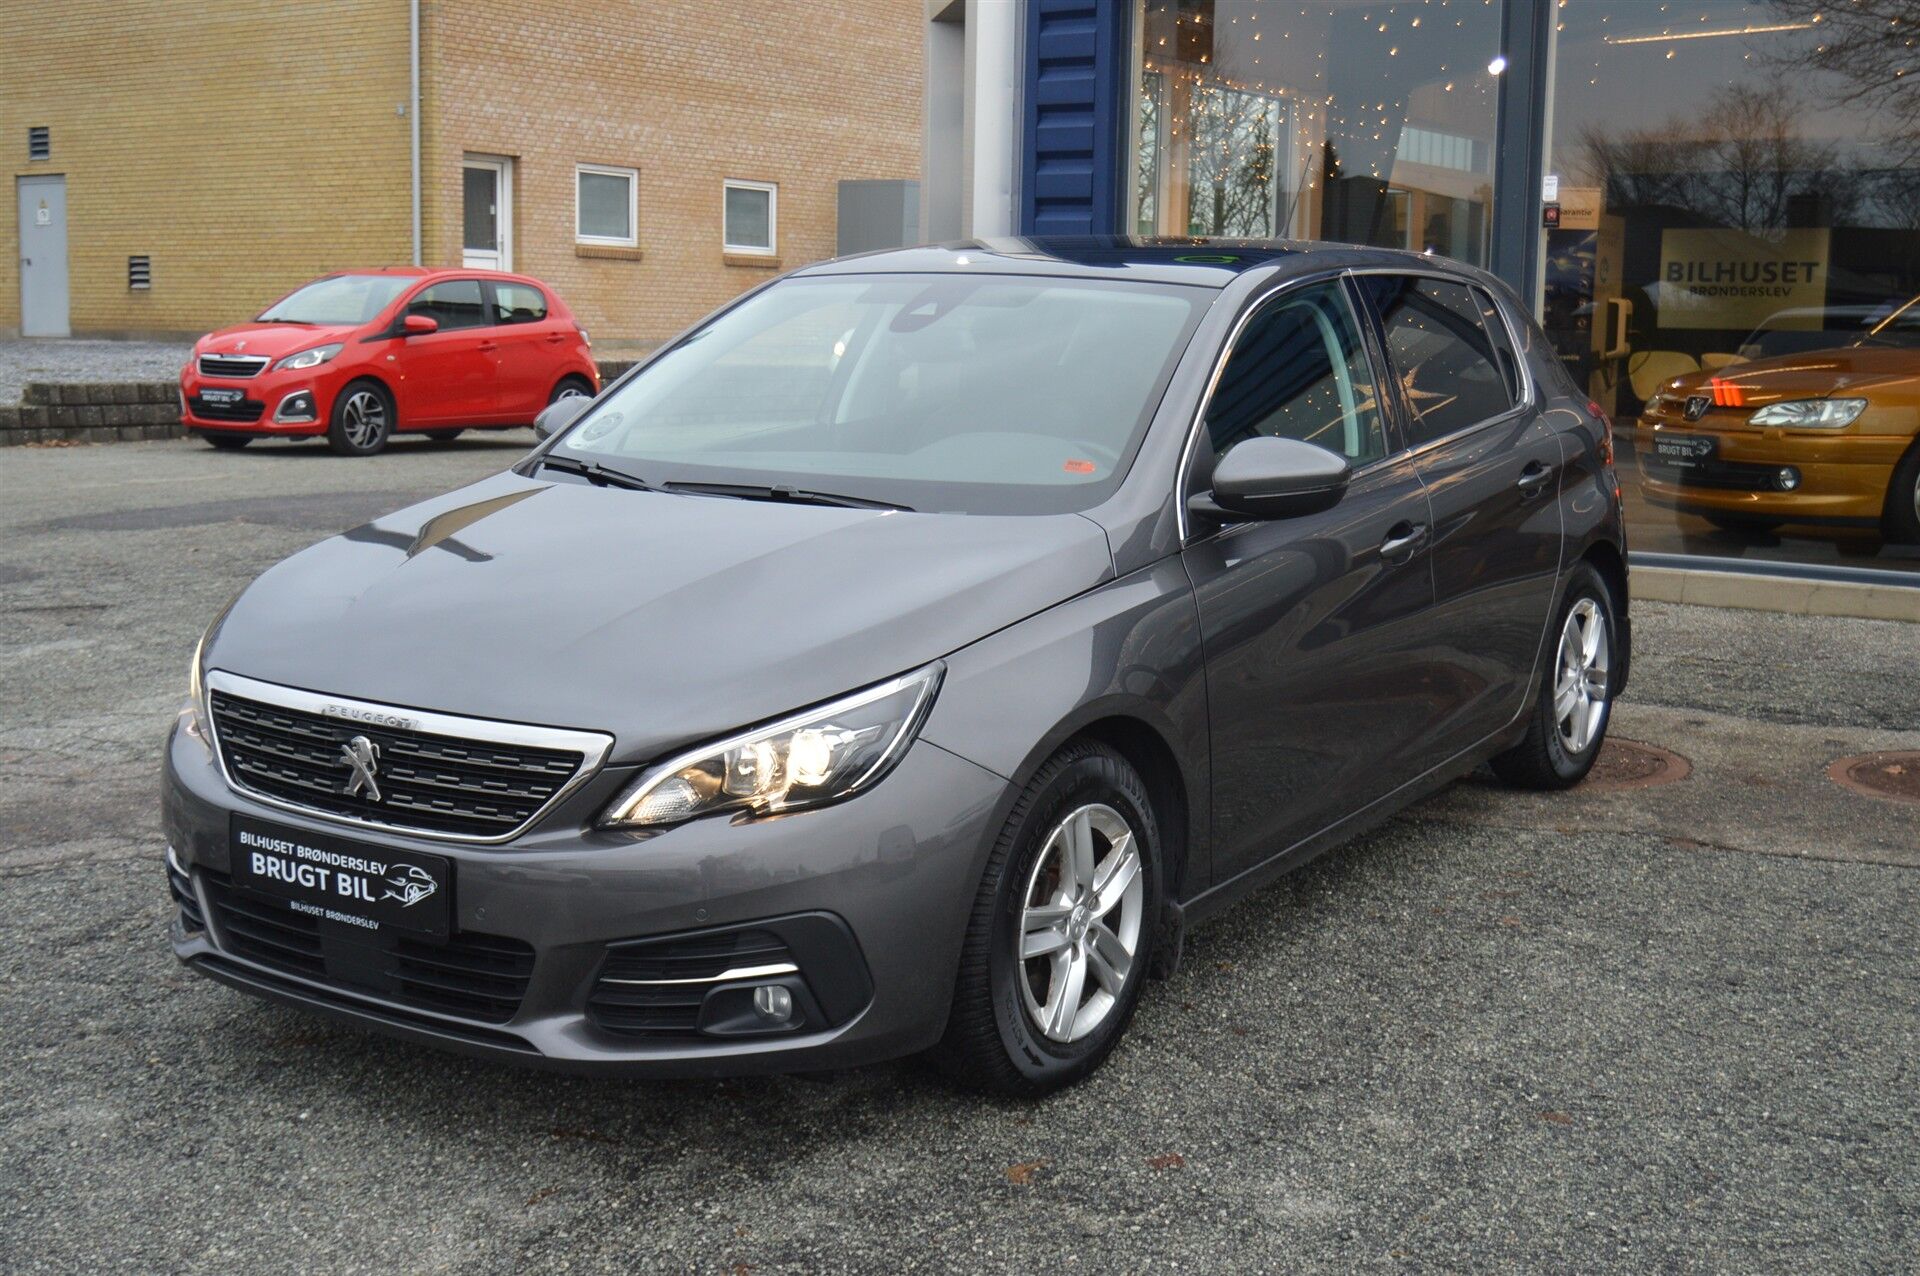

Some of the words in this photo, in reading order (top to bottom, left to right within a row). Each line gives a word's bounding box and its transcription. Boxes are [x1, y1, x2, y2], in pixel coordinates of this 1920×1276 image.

[1666, 261, 1820, 284] BILHUSET
[1689, 285, 1792, 297] BRØNDERSLEV
[1658, 443, 1680, 456] BRUGT
[1681, 446, 1694, 457] BIL
[329, 706, 411, 729] PEUGEOT
[240, 831, 295, 855] BILHUSET
[297, 845, 388, 876] BRØNDERSLEV
[252, 852, 331, 891] BRUGT
[337, 873, 376, 902] BIL
[290, 900, 324, 917] BILHUSET
[325, 909, 380, 930] BRØNDERSLEV
